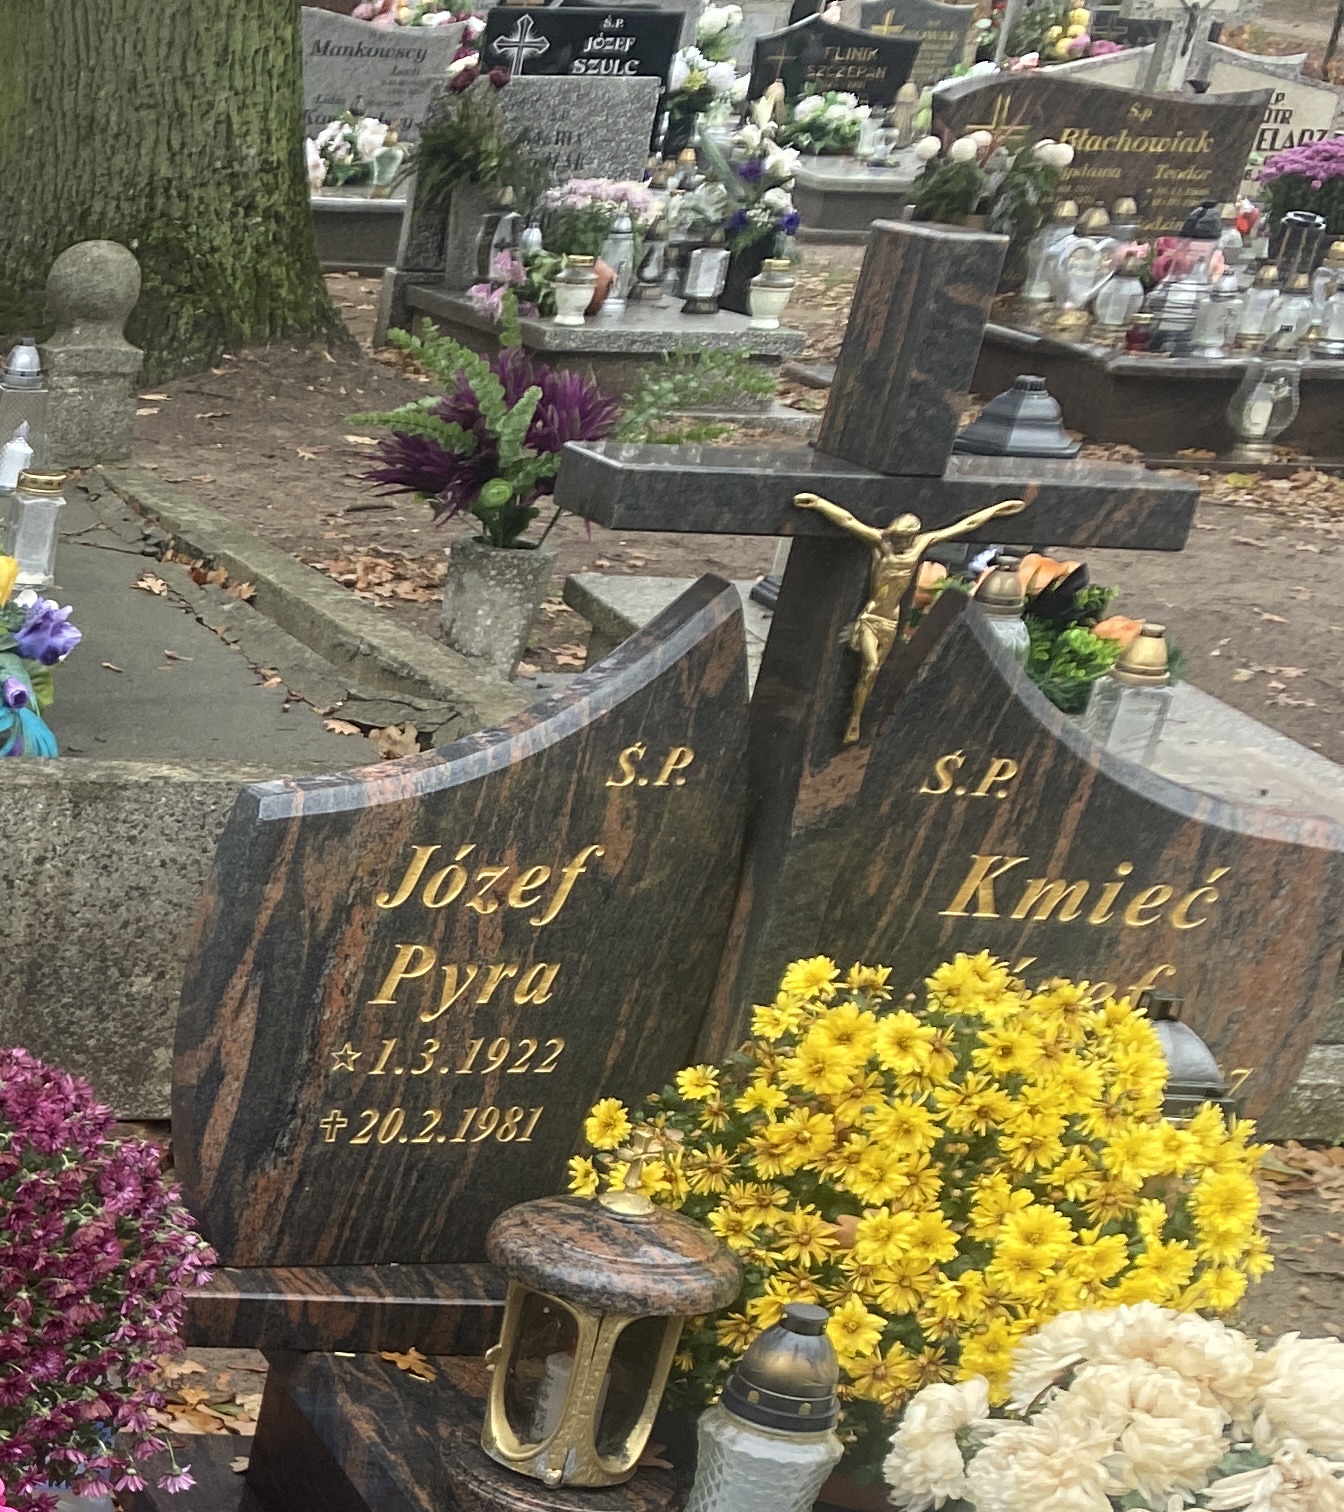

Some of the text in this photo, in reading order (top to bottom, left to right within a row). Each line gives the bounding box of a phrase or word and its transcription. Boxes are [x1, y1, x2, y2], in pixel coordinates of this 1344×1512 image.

[583, 32, 637, 53] JÓZEF
[571, 58, 641, 76] SZULC
[1062, 127, 1215, 154] Błachowiak
[604, 741, 695, 788] Ś.P.
[919, 749, 1019, 799] Ś.P.
[375, 843, 605, 927] Józef
[937, 853, 1232, 930] Kmieć
[367, 943, 562, 1024] Pyra
[368, 1036, 566, 1077] 1.3.1922
[349, 1105, 546, 1146] 20.2.1981
